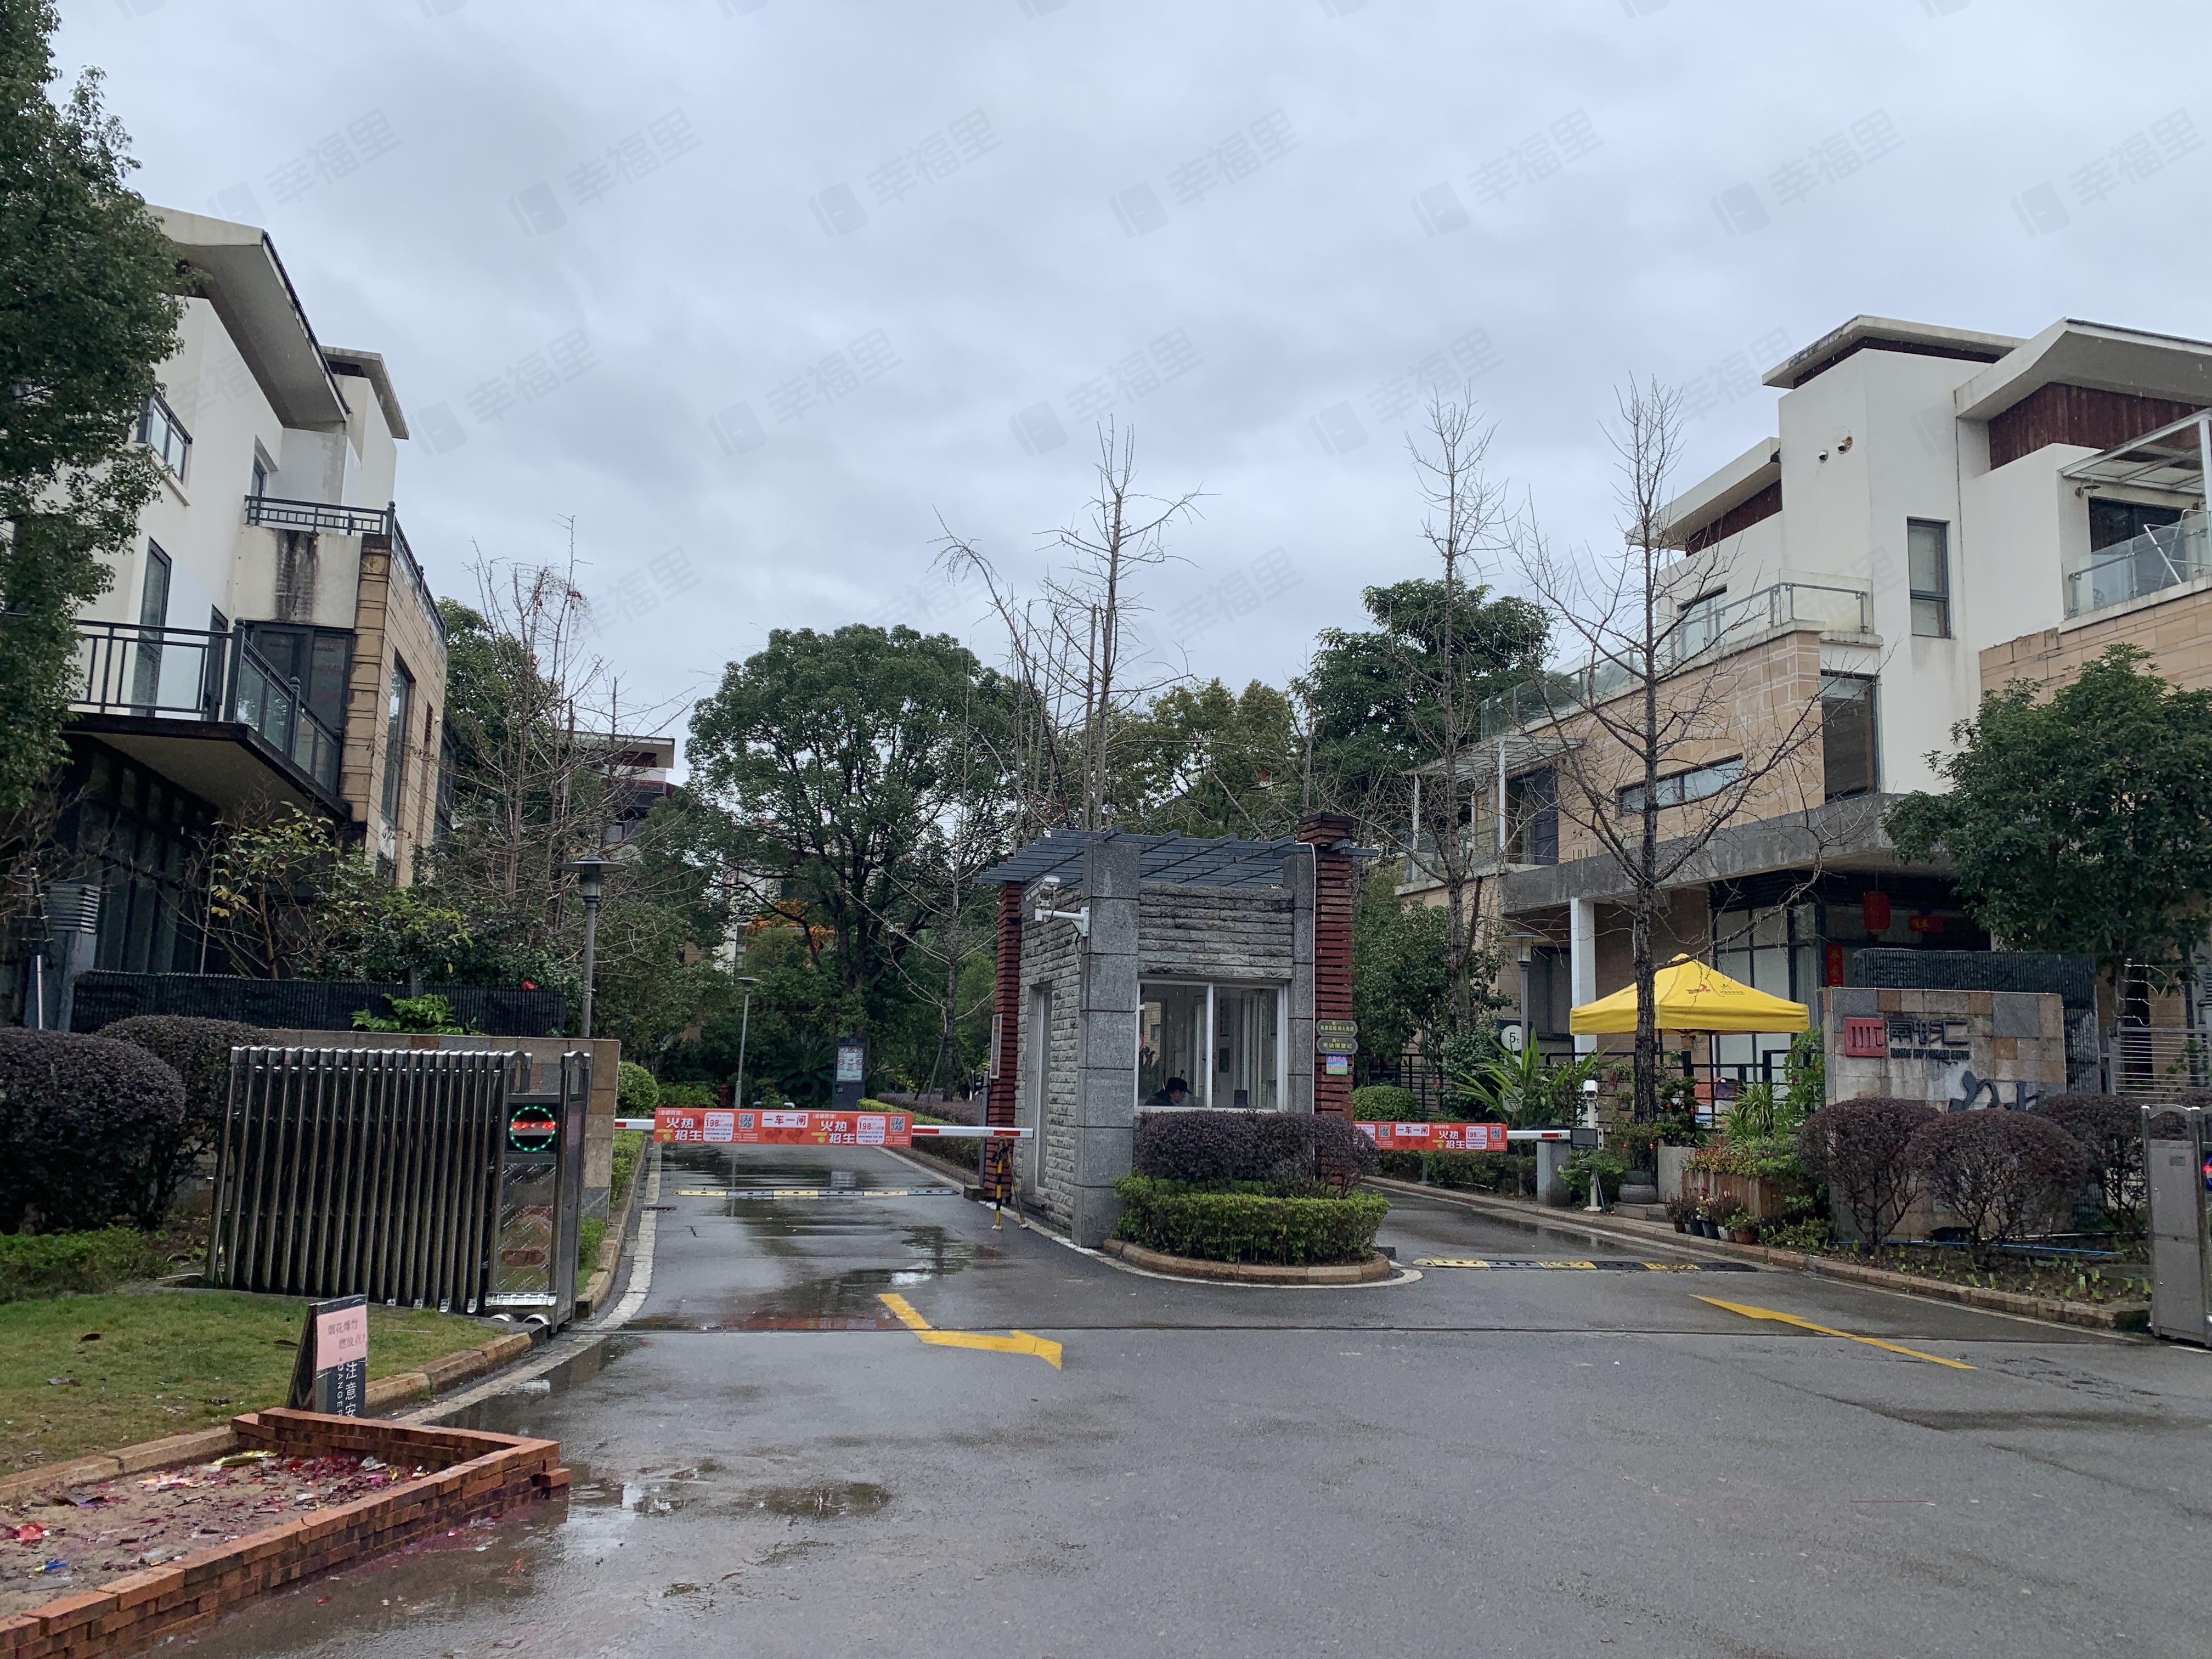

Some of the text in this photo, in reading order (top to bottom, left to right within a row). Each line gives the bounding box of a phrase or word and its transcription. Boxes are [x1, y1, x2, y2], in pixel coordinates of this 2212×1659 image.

[665, 1117, 694, 1129] 火热
[764, 1114, 806, 1126] 一车一闸
[820, 1120, 847, 1132] 火热
[1397, 1126, 1428, 1135] 一车一闸
[674, 1130, 702, 1141] 招生
[828, 1133, 856, 1144] 招生
[1439, 1130, 1459, 1139] 火热
[1446, 1140, 1465, 1149] 招生
[345, 1362, 358, 1418] 注意安
